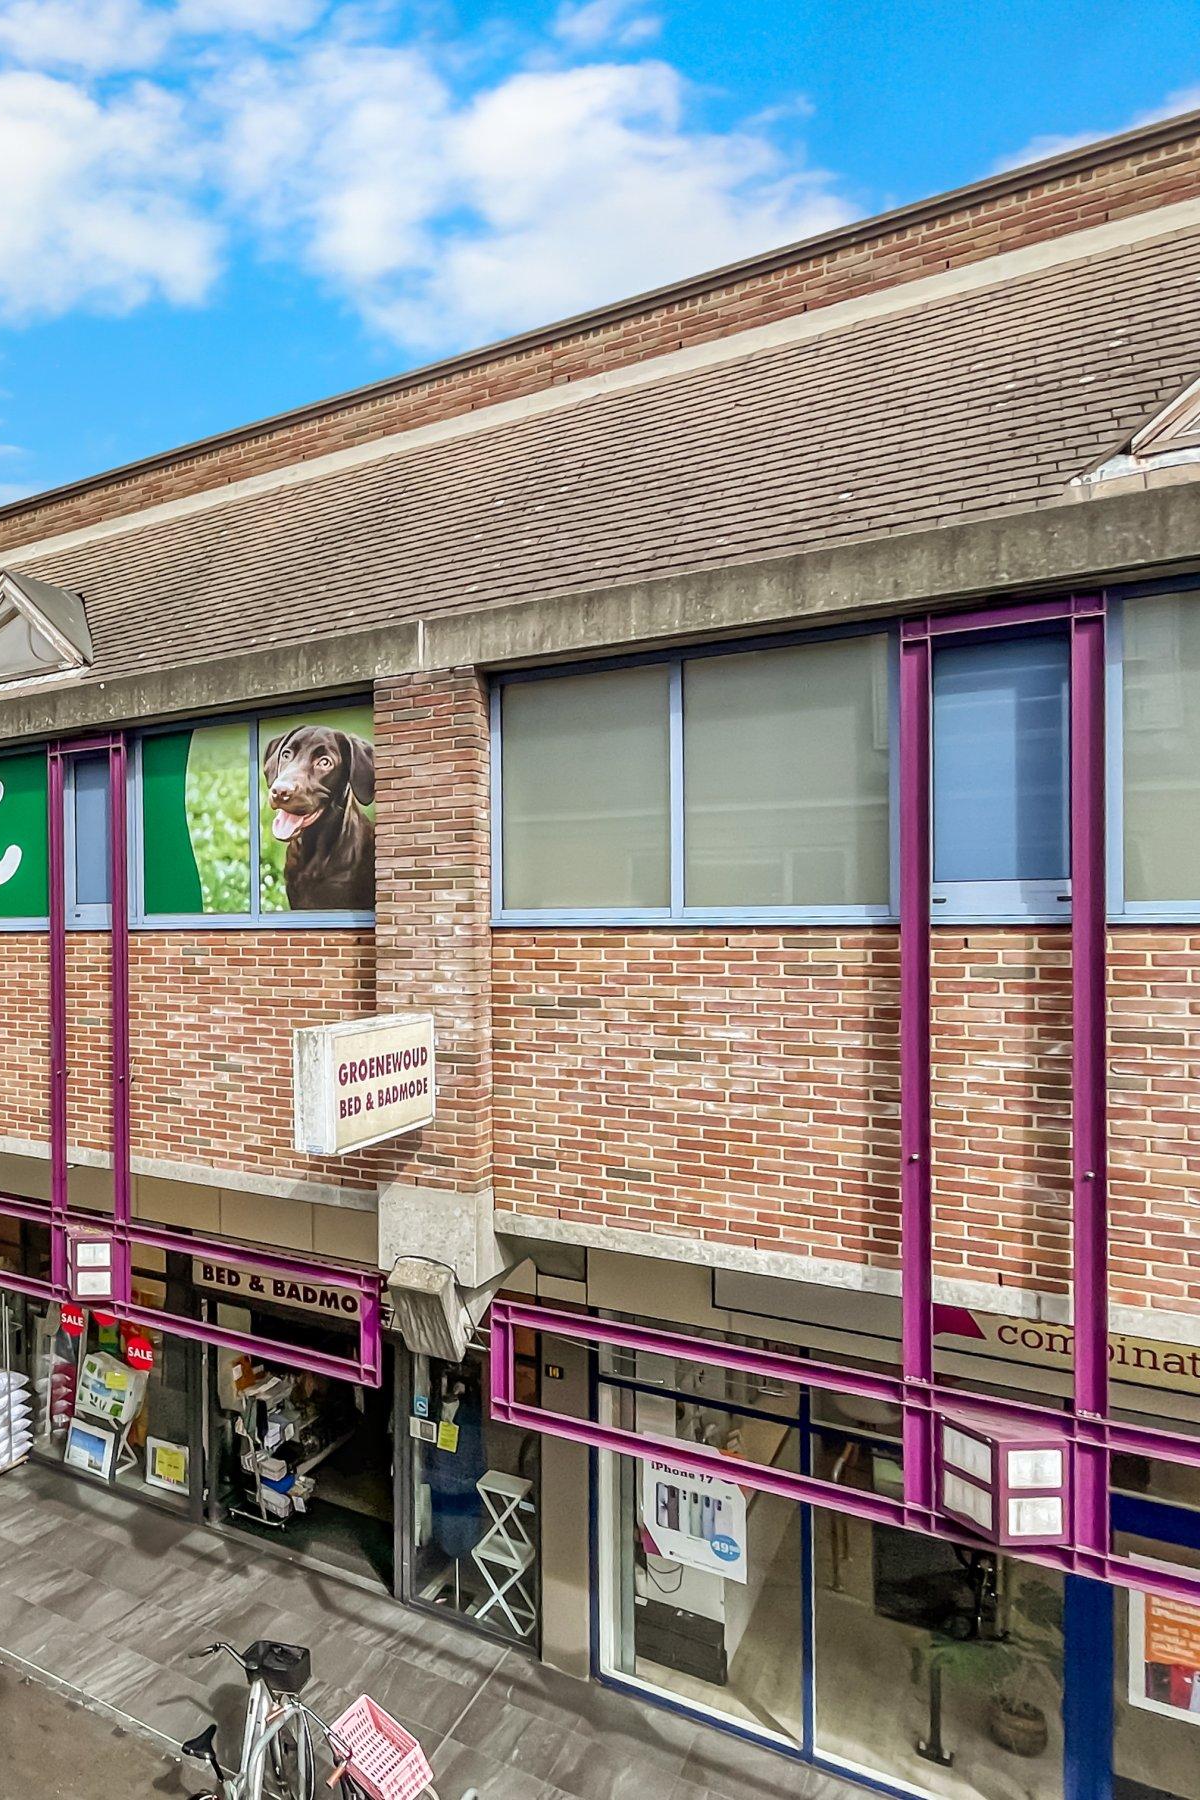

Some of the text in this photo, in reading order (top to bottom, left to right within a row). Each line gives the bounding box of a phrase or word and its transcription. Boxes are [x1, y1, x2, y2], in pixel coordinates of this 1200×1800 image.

[338, 1046, 428, 1086] GROENEWOUD
[339, 1077, 428, 1120] BED & BADMODE
[202, 1264, 241, 1287] BED
[248, 1275, 265, 1294] &
[272, 1279, 391, 1325] BADMOE
[61, 1312, 85, 1328] SALE
[127, 1346, 153, 1362] SALE
[997, 1324, 1200, 1379] cominat
[651, 1460, 714, 1484] iPhone 17
